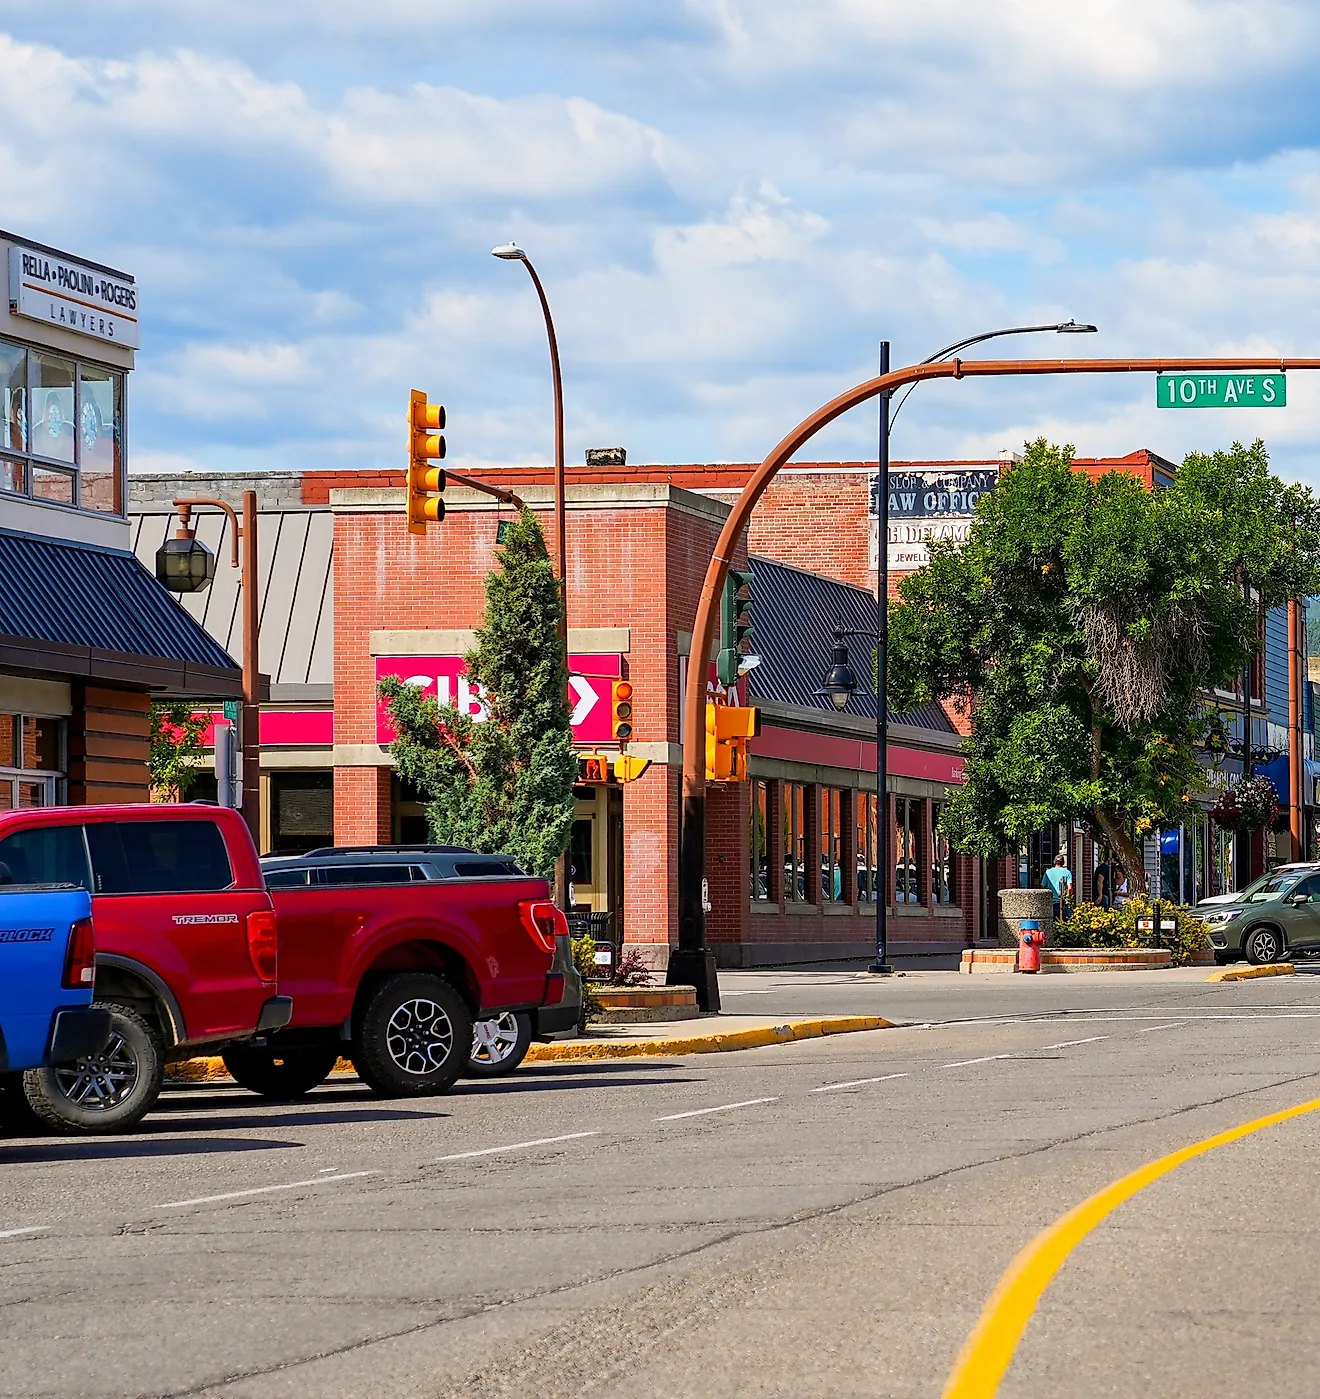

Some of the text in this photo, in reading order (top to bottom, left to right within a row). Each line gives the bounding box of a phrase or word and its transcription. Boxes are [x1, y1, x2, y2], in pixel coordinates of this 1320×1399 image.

[22, 253, 136, 310] RELLA PAOLINI ROGERS
[50, 303, 114, 337] LAWYERS
[1167, 378, 1276, 403] 10TH AVE S
[923, 491, 986, 511] OFFIC
[172, 914, 239, 925] TREMOR
